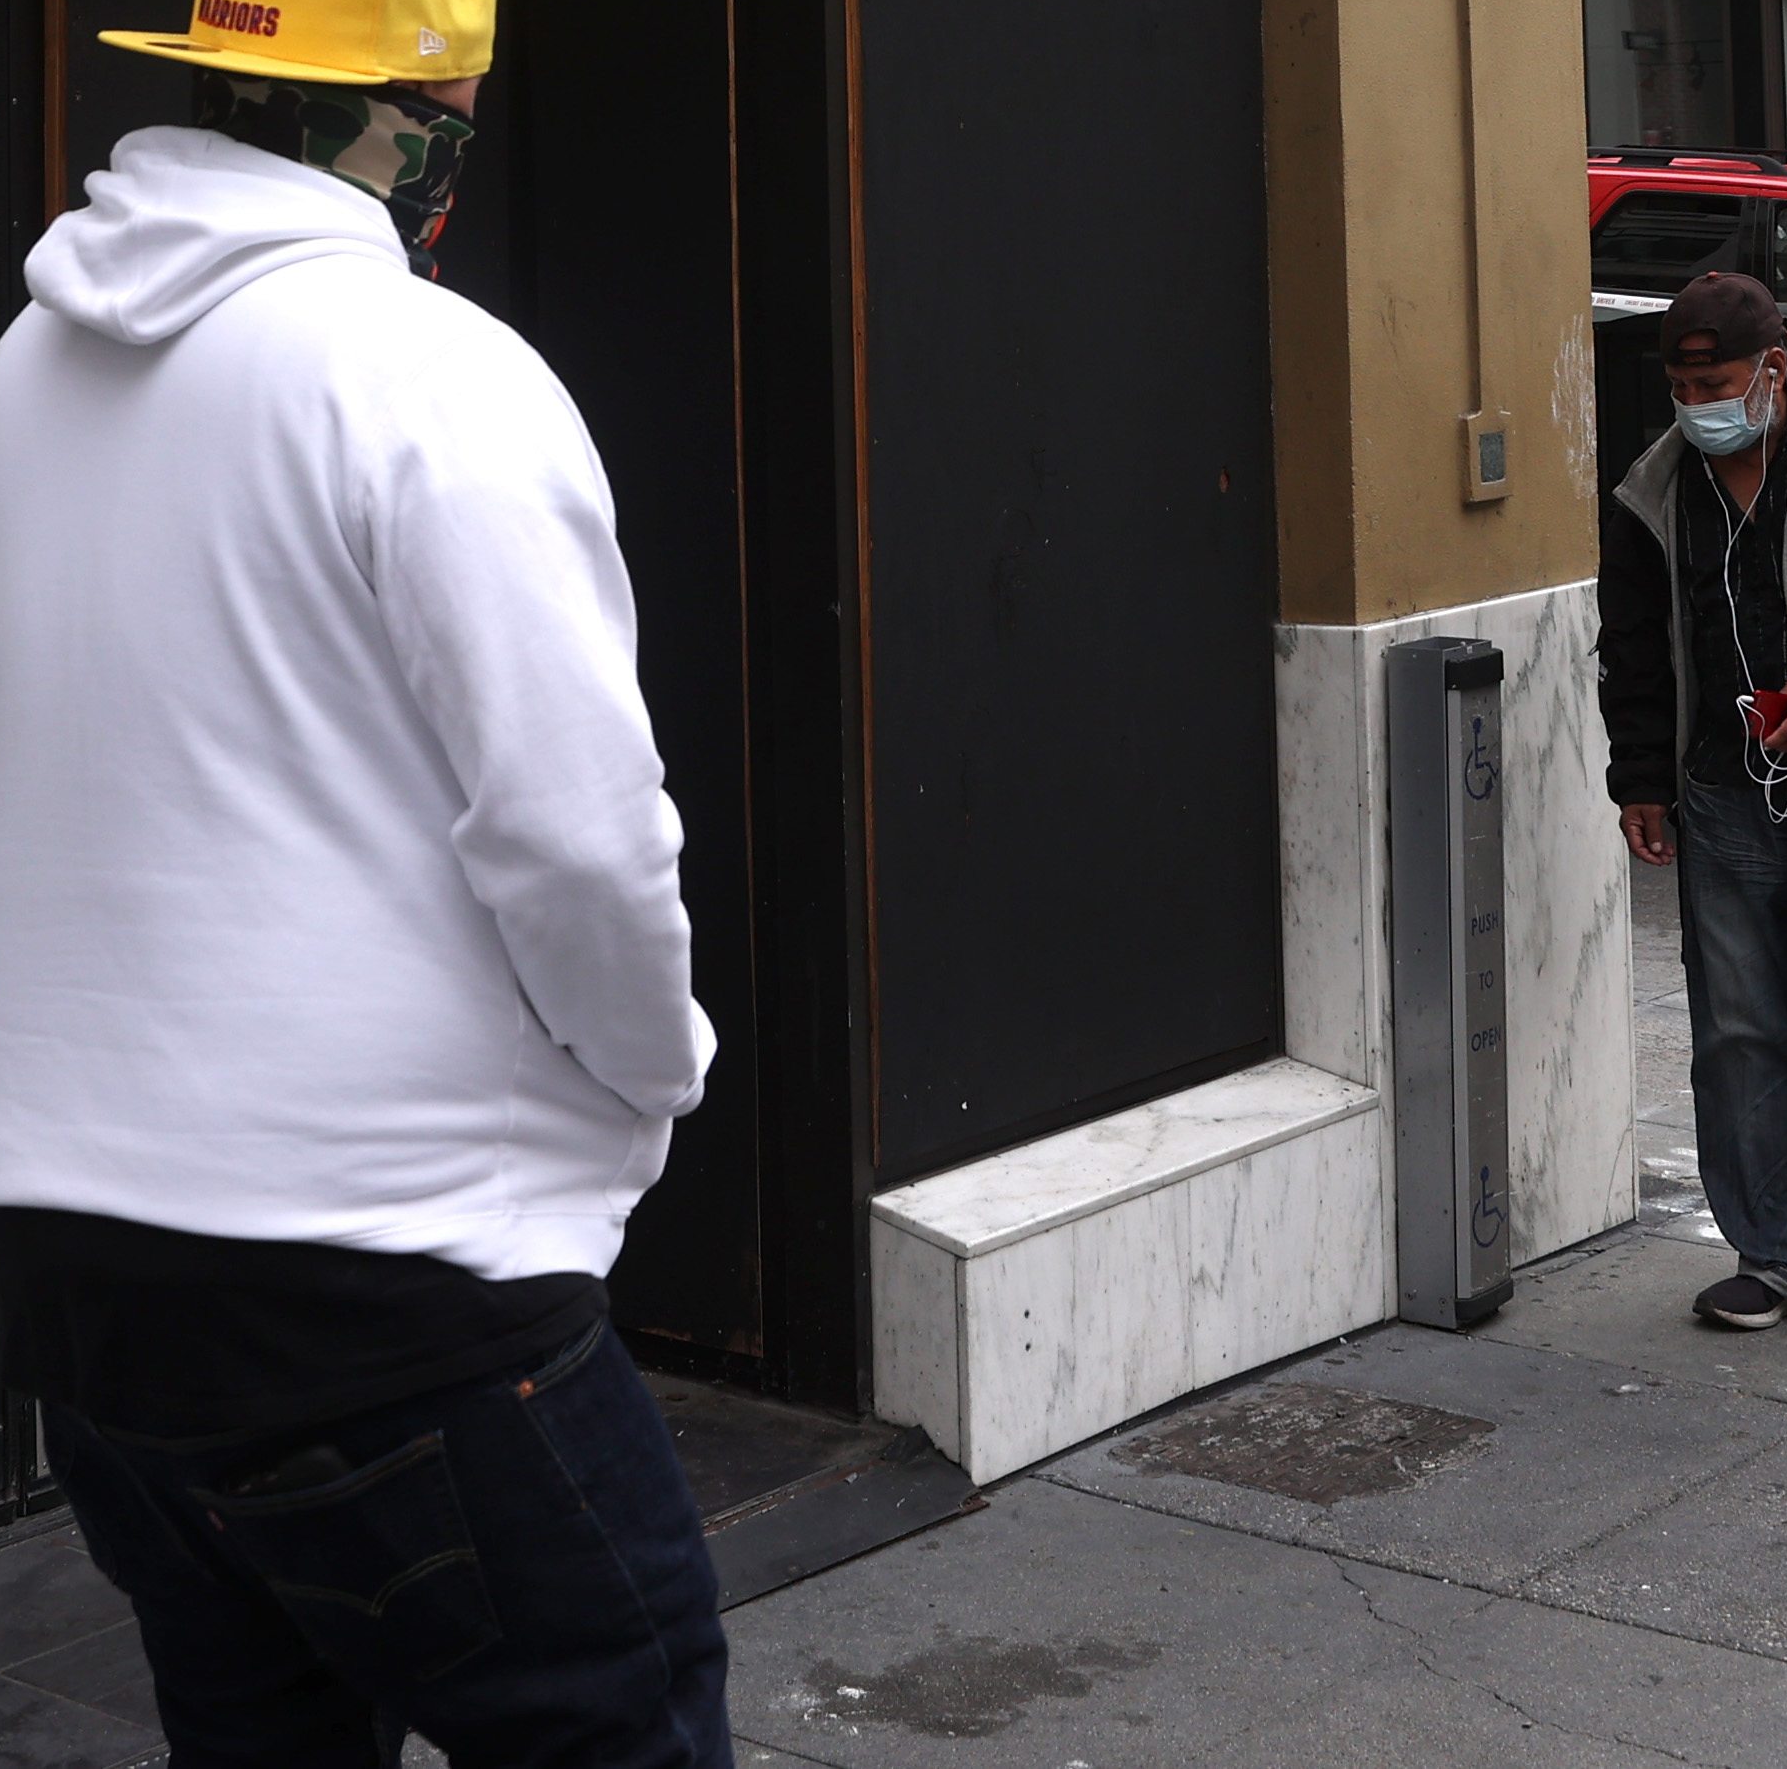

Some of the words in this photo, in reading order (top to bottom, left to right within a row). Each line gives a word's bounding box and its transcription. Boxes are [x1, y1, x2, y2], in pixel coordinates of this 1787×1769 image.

[1472, 911, 1499, 937] PUSH
[1478, 970, 1494, 990] TO
[1471, 1026, 1501, 1052] OPEN
